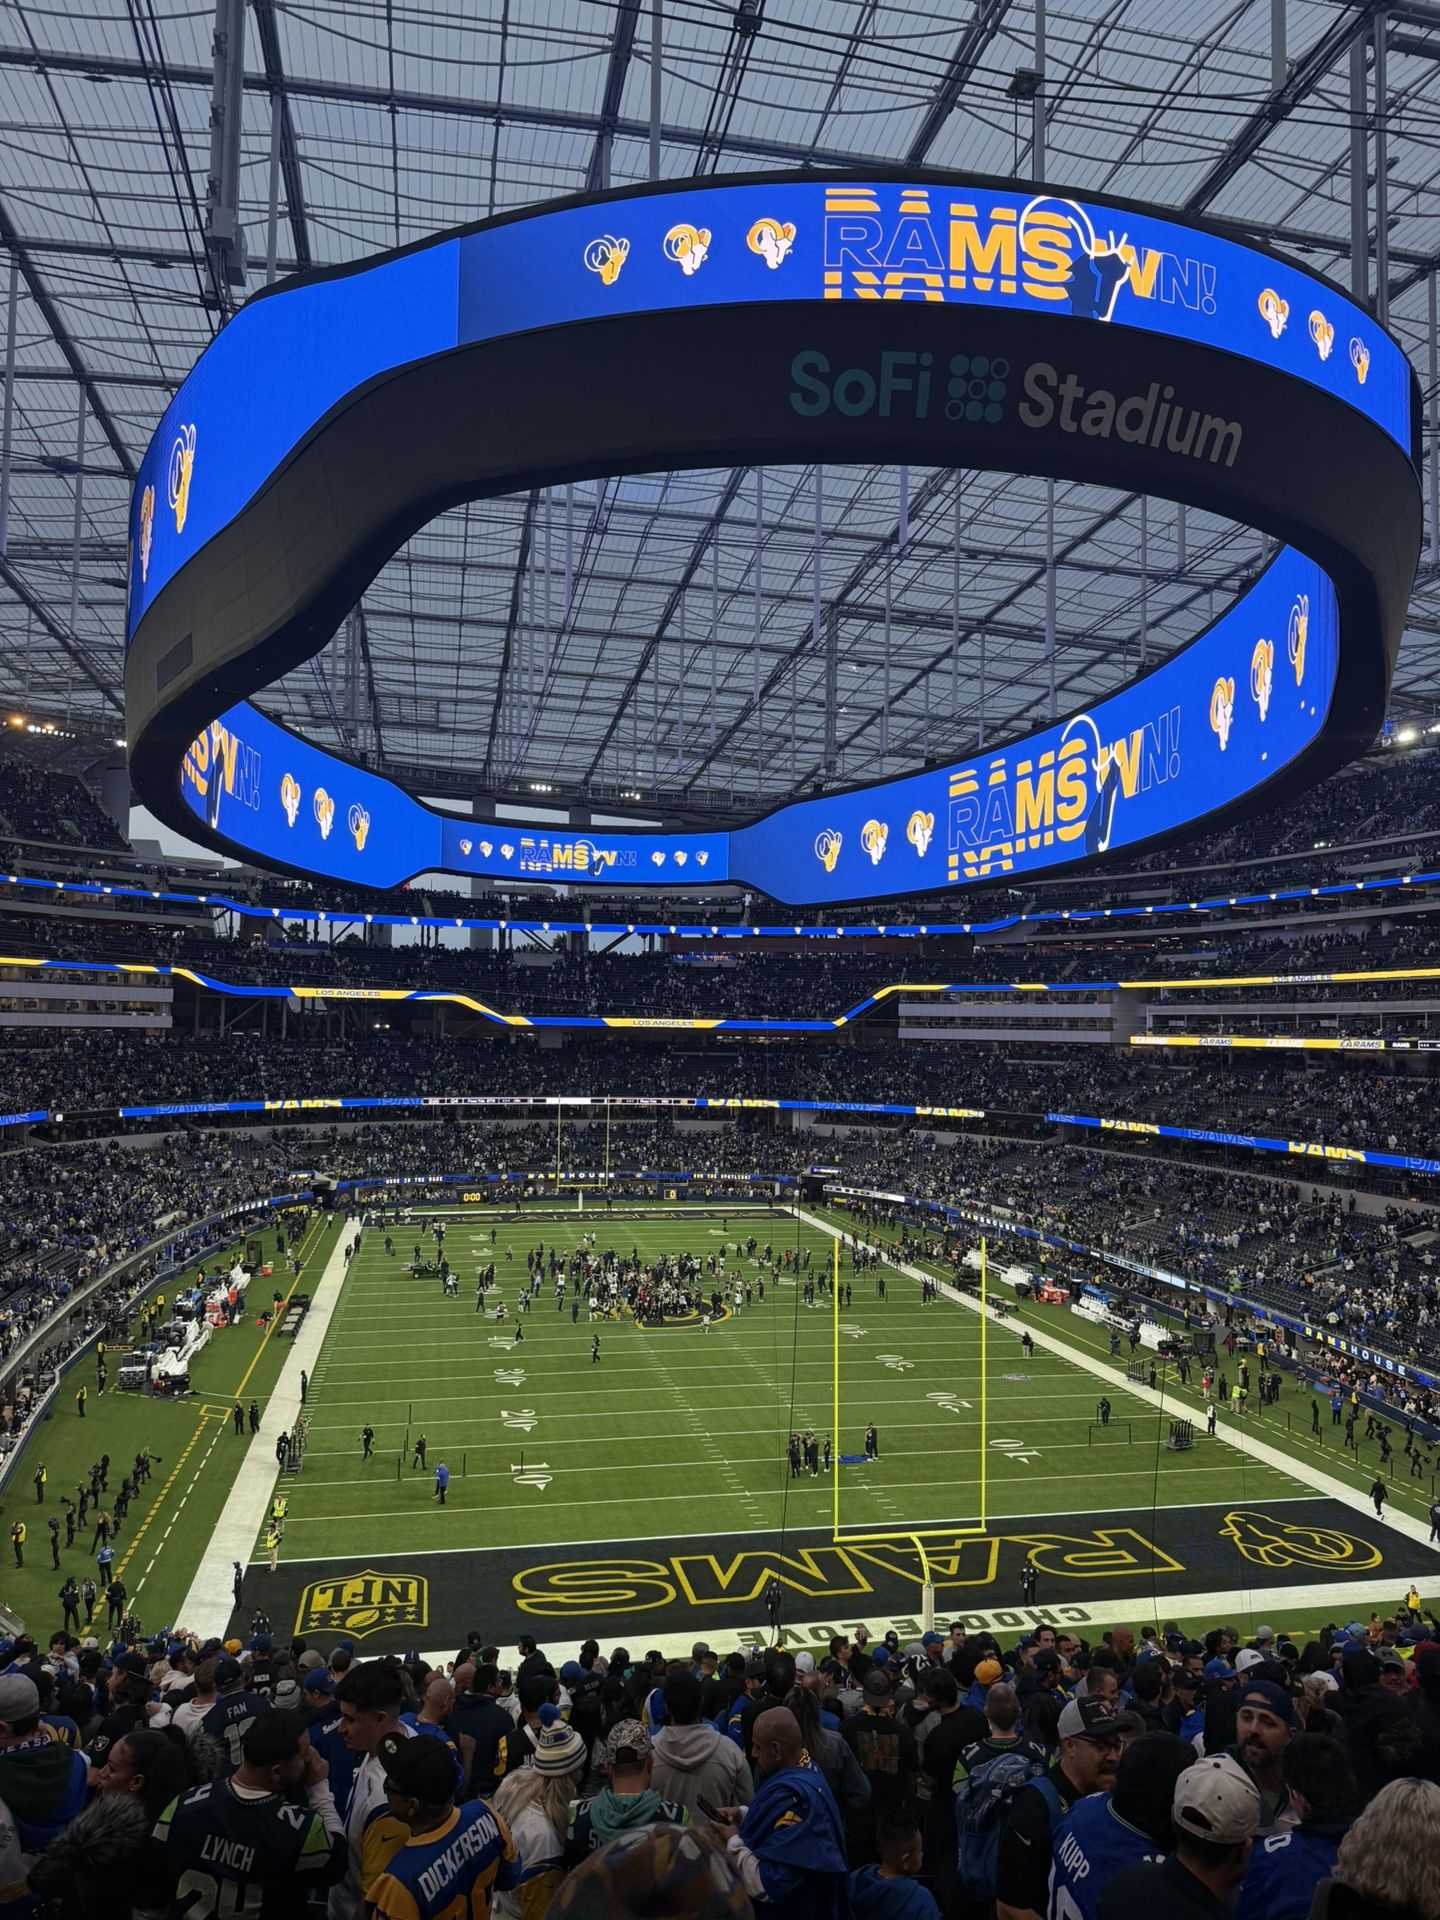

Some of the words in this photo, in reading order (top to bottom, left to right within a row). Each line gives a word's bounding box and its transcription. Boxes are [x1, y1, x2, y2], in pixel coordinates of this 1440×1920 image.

[824, 205, 1073, 290] RAMS
[790, 350, 933, 419] SoFi
[1018, 361, 1243, 468] Stadium
[948, 750, 1087, 862] RAMS
[520, 844, 589, 868] RAMS
[315, 989, 335, 997] LOS
[337, 989, 381, 997] ANGELES
[653, 1020, 694, 1028] ANGELES
[1353, 1041, 1381, 1049] RAMS
[463, 1192, 481, 1202] 0:00
[876, 1354, 915, 1368] 30
[494, 1368, 527, 1383] 30
[926, 1392, 973, 1409] 20
[501, 1409, 538, 1427] 20
[989, 1439, 1042, 1459] 10
[511, 1462, 553, 1484] 10
[511, 1528, 1187, 1617] RAMS
[318, 1577, 415, 1609] NFL
[888, 1606, 1093, 1637] CHOOSE
[227, 1702, 247, 1719] FAN
[200, 1834, 255, 1873] LYNCH
[417, 1811, 500, 1904] DICKERSON
[1058, 1831, 1091, 1884] KUPP
